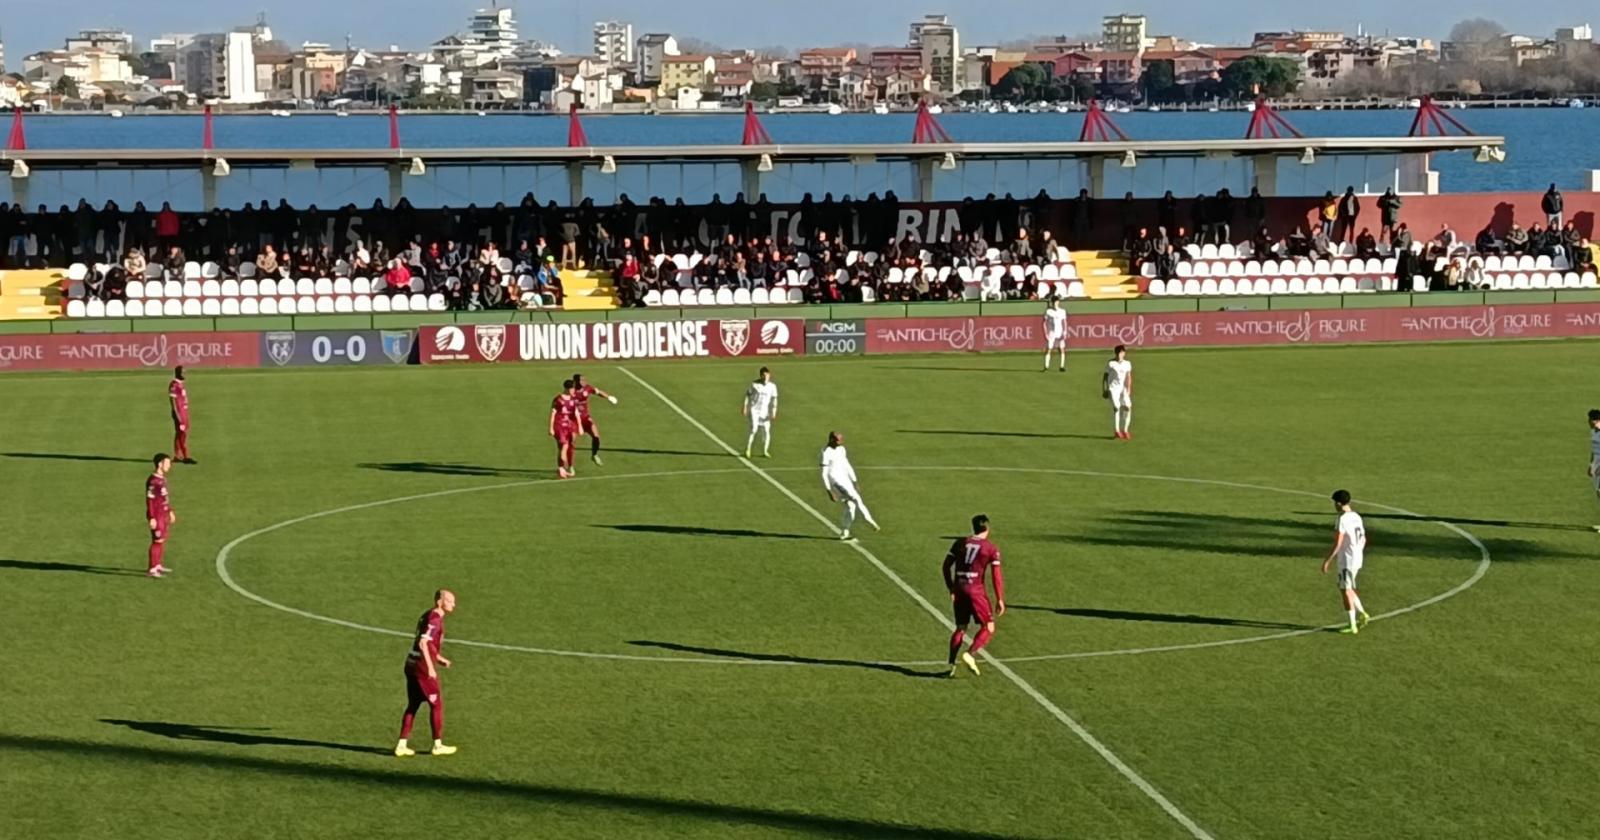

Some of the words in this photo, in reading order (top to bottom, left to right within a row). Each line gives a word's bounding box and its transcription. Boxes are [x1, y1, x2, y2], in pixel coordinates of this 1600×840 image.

[1319, 318, 1367, 334] FIGURE
[1503, 313, 1552, 328] FIGURE
[983, 325, 1033, 341] FIGURE
[1066, 324, 1121, 339] NTICHE
[1153, 321, 1202, 339] FIGURE
[519, 323, 588, 360] UNION
[592, 320, 709, 359] CLODIENSE
[815, 339, 856, 354] 00:00
[0, 345, 43, 360] GURE
[177, 342, 232, 359] FIGURE
[311, 335, 367, 363] 0-0
[964, 543, 980, 563] 17
